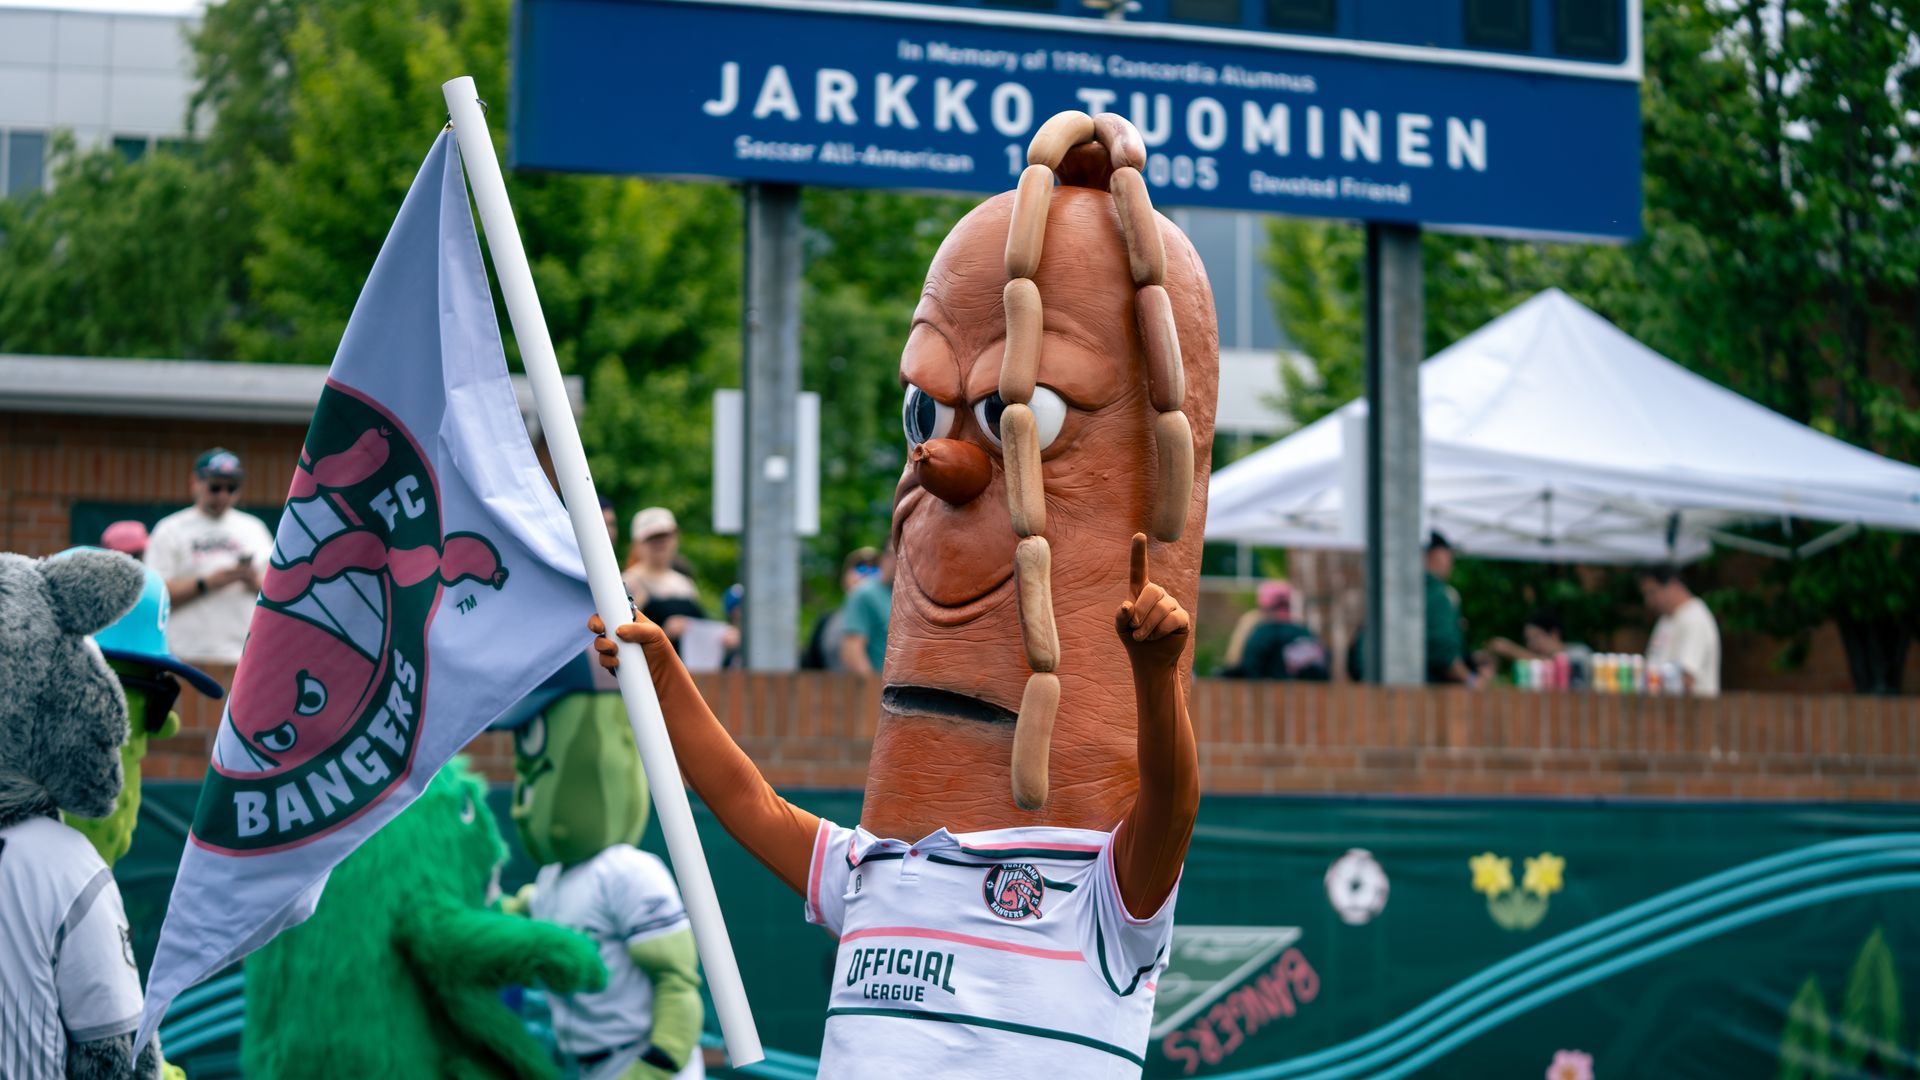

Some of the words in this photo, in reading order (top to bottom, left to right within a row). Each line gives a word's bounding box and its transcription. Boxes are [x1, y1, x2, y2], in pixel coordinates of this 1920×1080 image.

[898, 40, 924, 60] In
[926, 41, 1018, 72] Memory
[1021, 50, 1047, 70] of
[1107, 55, 1218, 85] Concordia
[1219, 65, 1317, 93] Alumnus
[702, 60, 1034, 138] JARKKO
[1074, 87, 1488, 172] TUOMINEN
[734, 135, 816, 161] Soccer
[818, 142, 974, 173] All-American
[1250, 170, 1338, 199] Devoted
[1340, 177, 1411, 204] Friend
[369, 474, 426, 533] FC
[456, 593, 477, 616] TM
[233, 648, 417, 838] BANGERS
[990, 901, 1024, 918] BANGERS
[846, 948, 956, 996] OFFICIAL
[863, 983, 925, 1002] LEAGUE
[1163, 947, 1320, 1074] BANGERS
